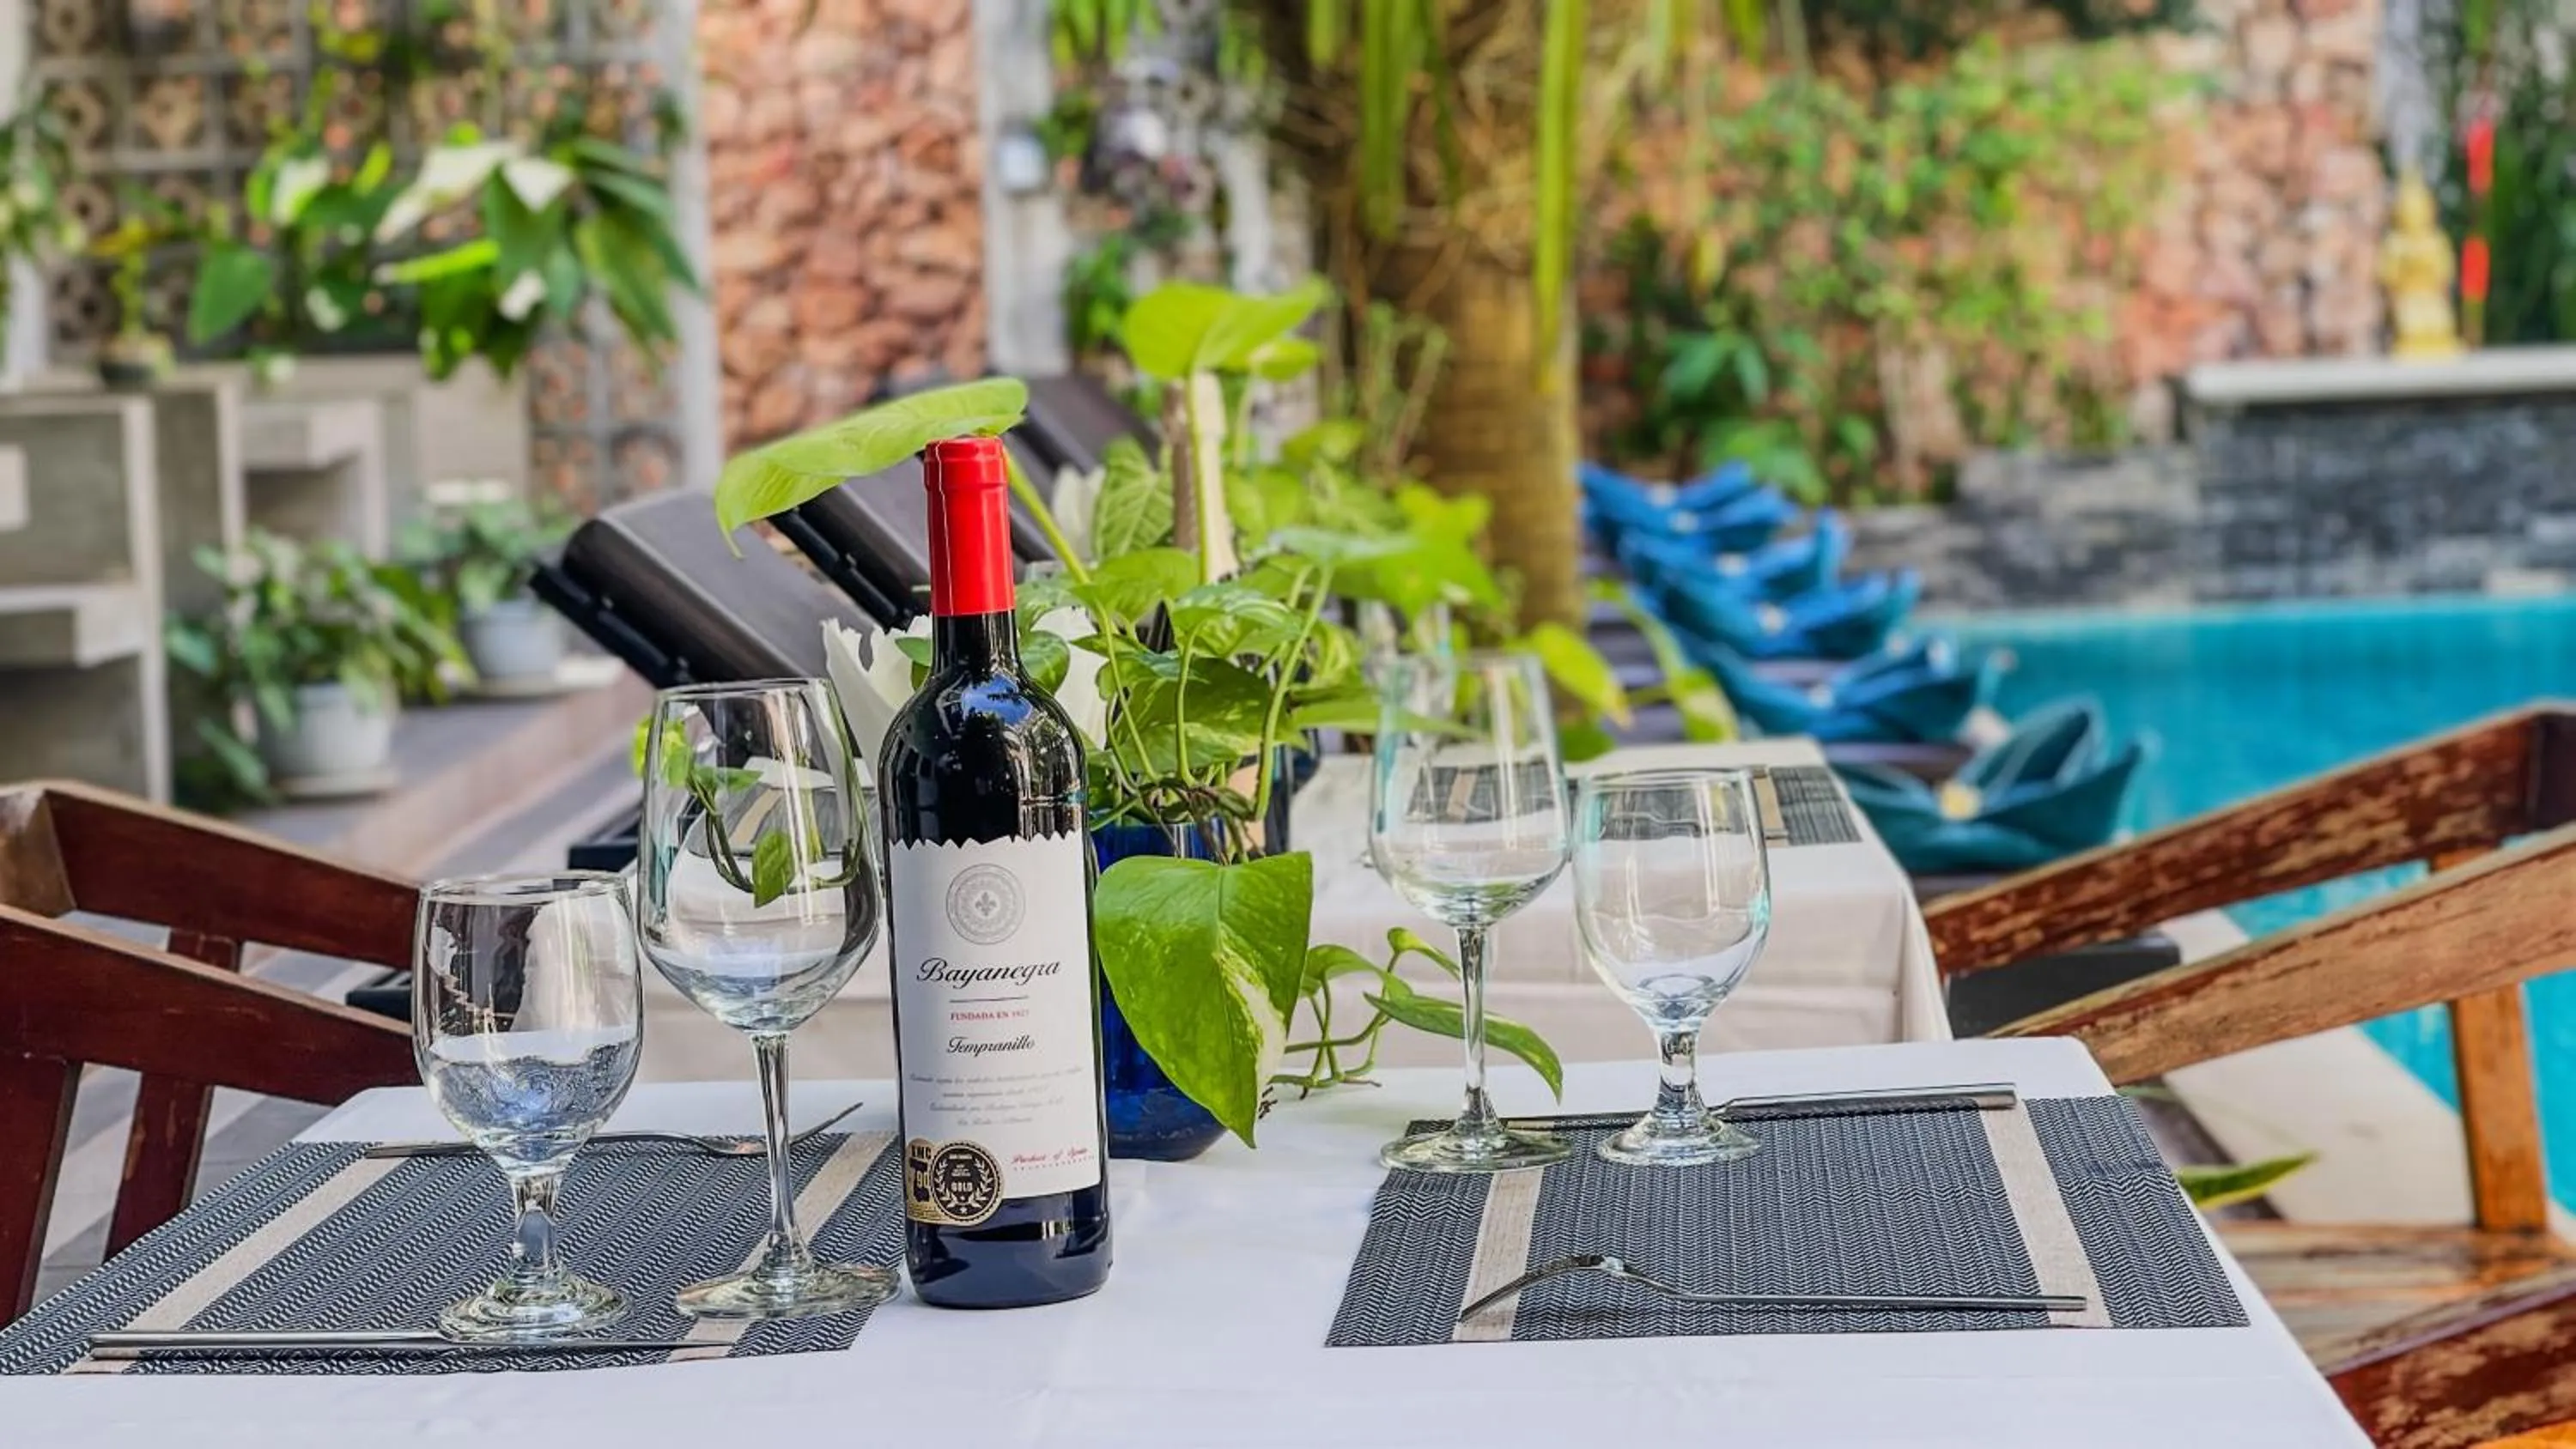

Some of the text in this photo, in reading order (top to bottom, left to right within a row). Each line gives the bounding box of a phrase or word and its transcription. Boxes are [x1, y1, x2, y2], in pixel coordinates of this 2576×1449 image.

[916, 957, 1060, 989] Bayanegra
[950, 1011, 994, 1021] FUNDADA
[997, 1010, 1009, 1019] EN
[946, 1034, 1035, 1057] Tempranillo
[916, 1170, 930, 1188] 90
